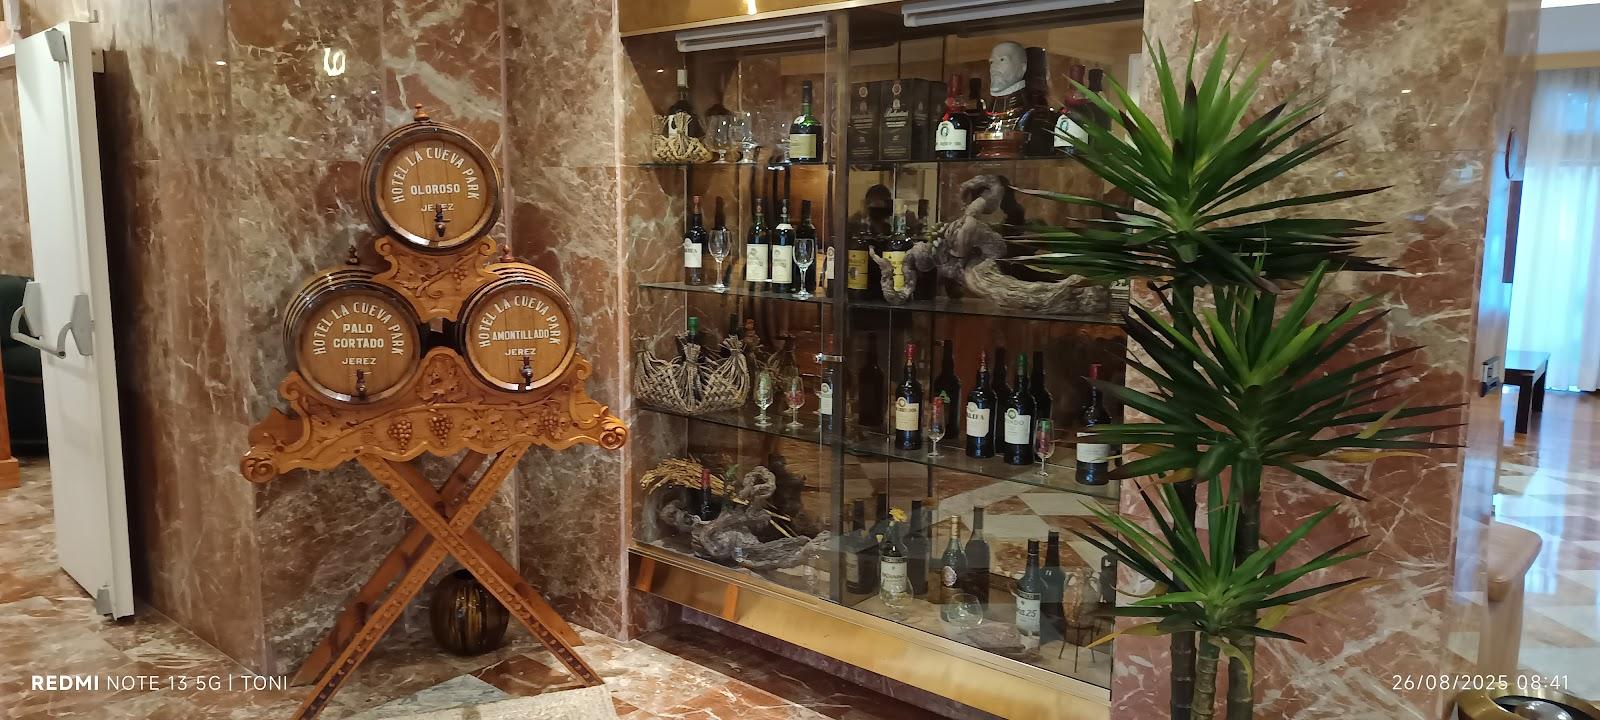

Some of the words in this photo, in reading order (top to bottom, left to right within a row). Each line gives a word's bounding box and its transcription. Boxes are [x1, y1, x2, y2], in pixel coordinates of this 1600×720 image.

[391, 166, 409, 203] HOTEL
[407, 150, 424, 166] LA
[426, 147, 465, 168] CUEVA
[462, 168, 480, 200] PARK
[410, 183, 461, 195] OLOROSO
[421, 203, 455, 212] JEEZ
[478, 312, 497, 348] HOTEL
[494, 298, 512, 313] LA
[514, 295, 550, 316] CUEVA
[546, 315, 561, 345] PARK
[313, 318, 334, 355] HOTEL
[331, 304, 350, 319] LA
[353, 301, 393, 324] CUEVA
[388, 324, 405, 355] PARK
[342, 323, 374, 334] PALO
[492, 329, 550, 341] AMONTILLADO
[333, 338, 385, 348] CORTADO
[505, 347, 537, 356] JEREZ
[341, 357, 377, 365] JEREZ
